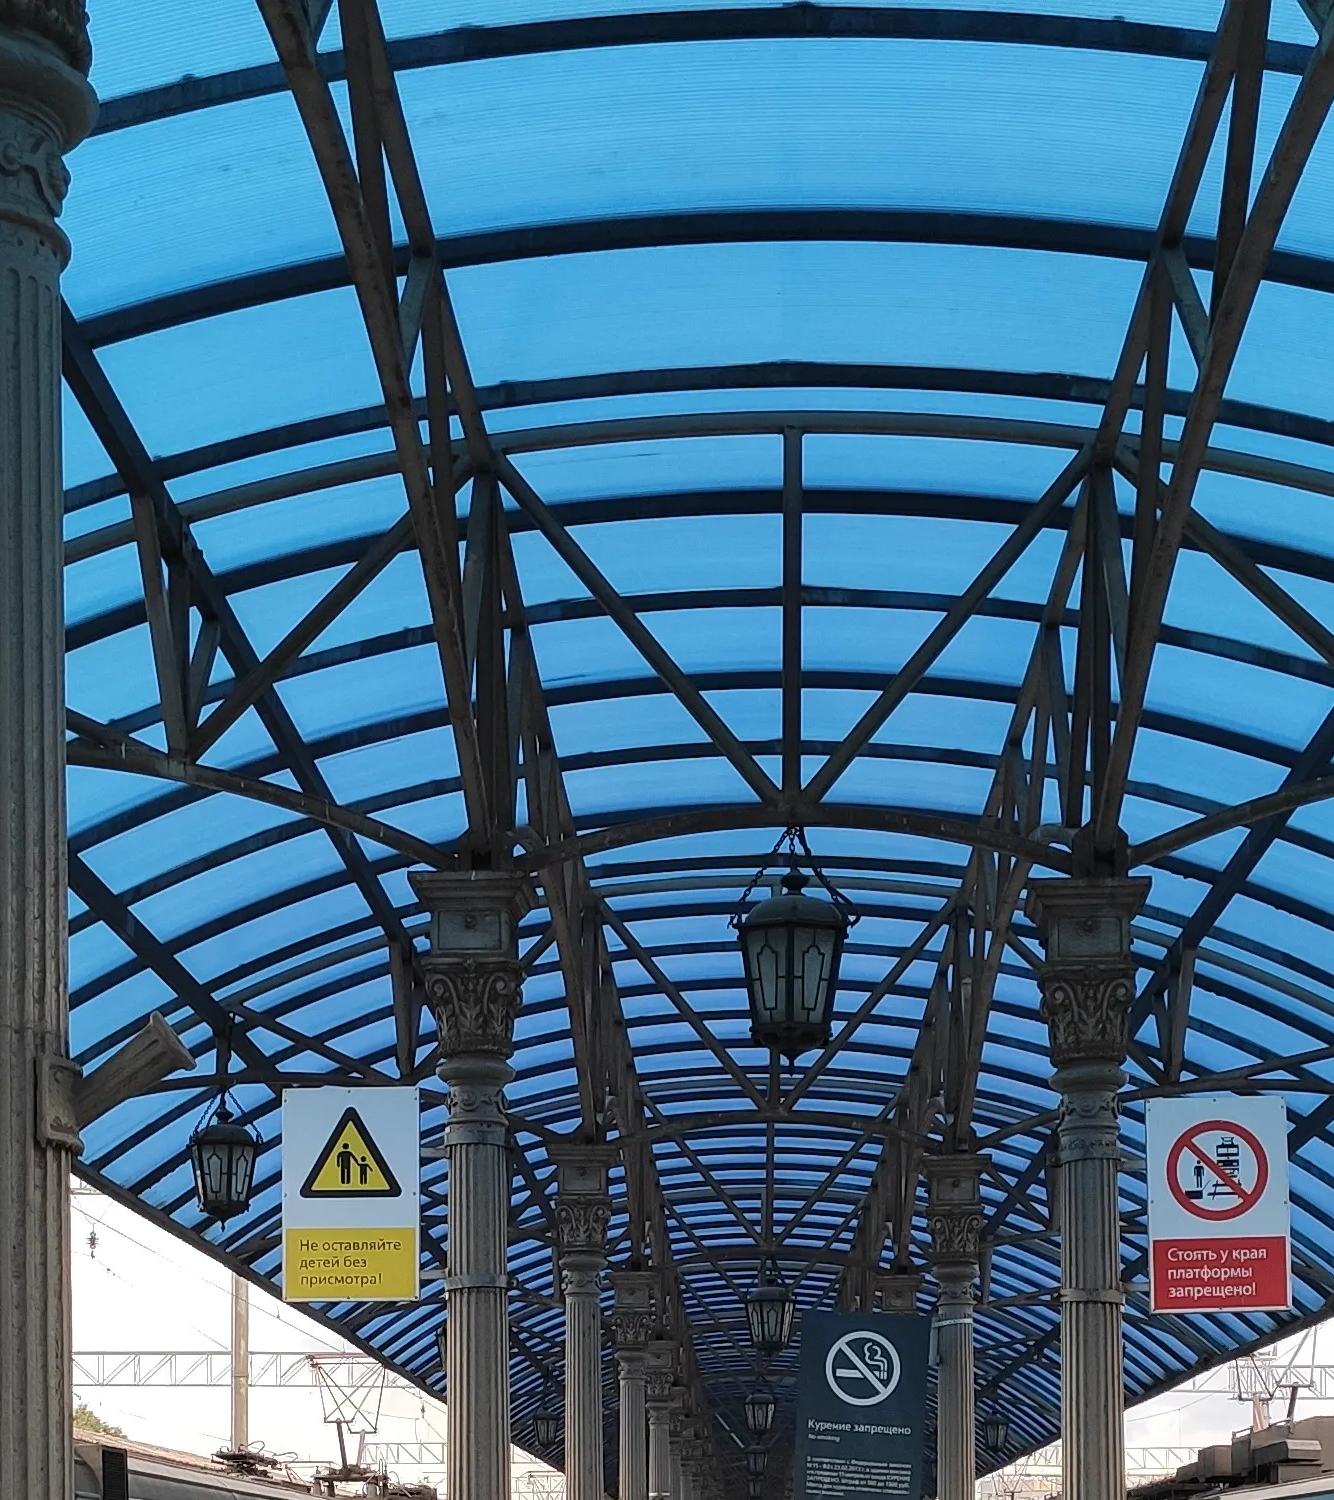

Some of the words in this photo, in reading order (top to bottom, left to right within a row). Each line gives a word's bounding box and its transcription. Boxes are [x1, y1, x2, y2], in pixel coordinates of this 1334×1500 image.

[300, 1239, 318, 1252] Не
[322, 1238, 402, 1252] оставляйте
[299, 1256, 340, 1271] детей
[343, 1255, 367, 1268] без
[1167, 1248, 1217, 1261] Стоять
[1220, 1250, 1230, 1264] у
[1232, 1248, 1267, 1262] края
[300, 1271, 382, 1288] присмотра!
[1167, 1265, 1252, 1281] платформы
[1168, 1282, 1256, 1300] запрещено!
[808, 1419, 852, 1431] Курение
[853, 1424, 912, 1435] запрещено
